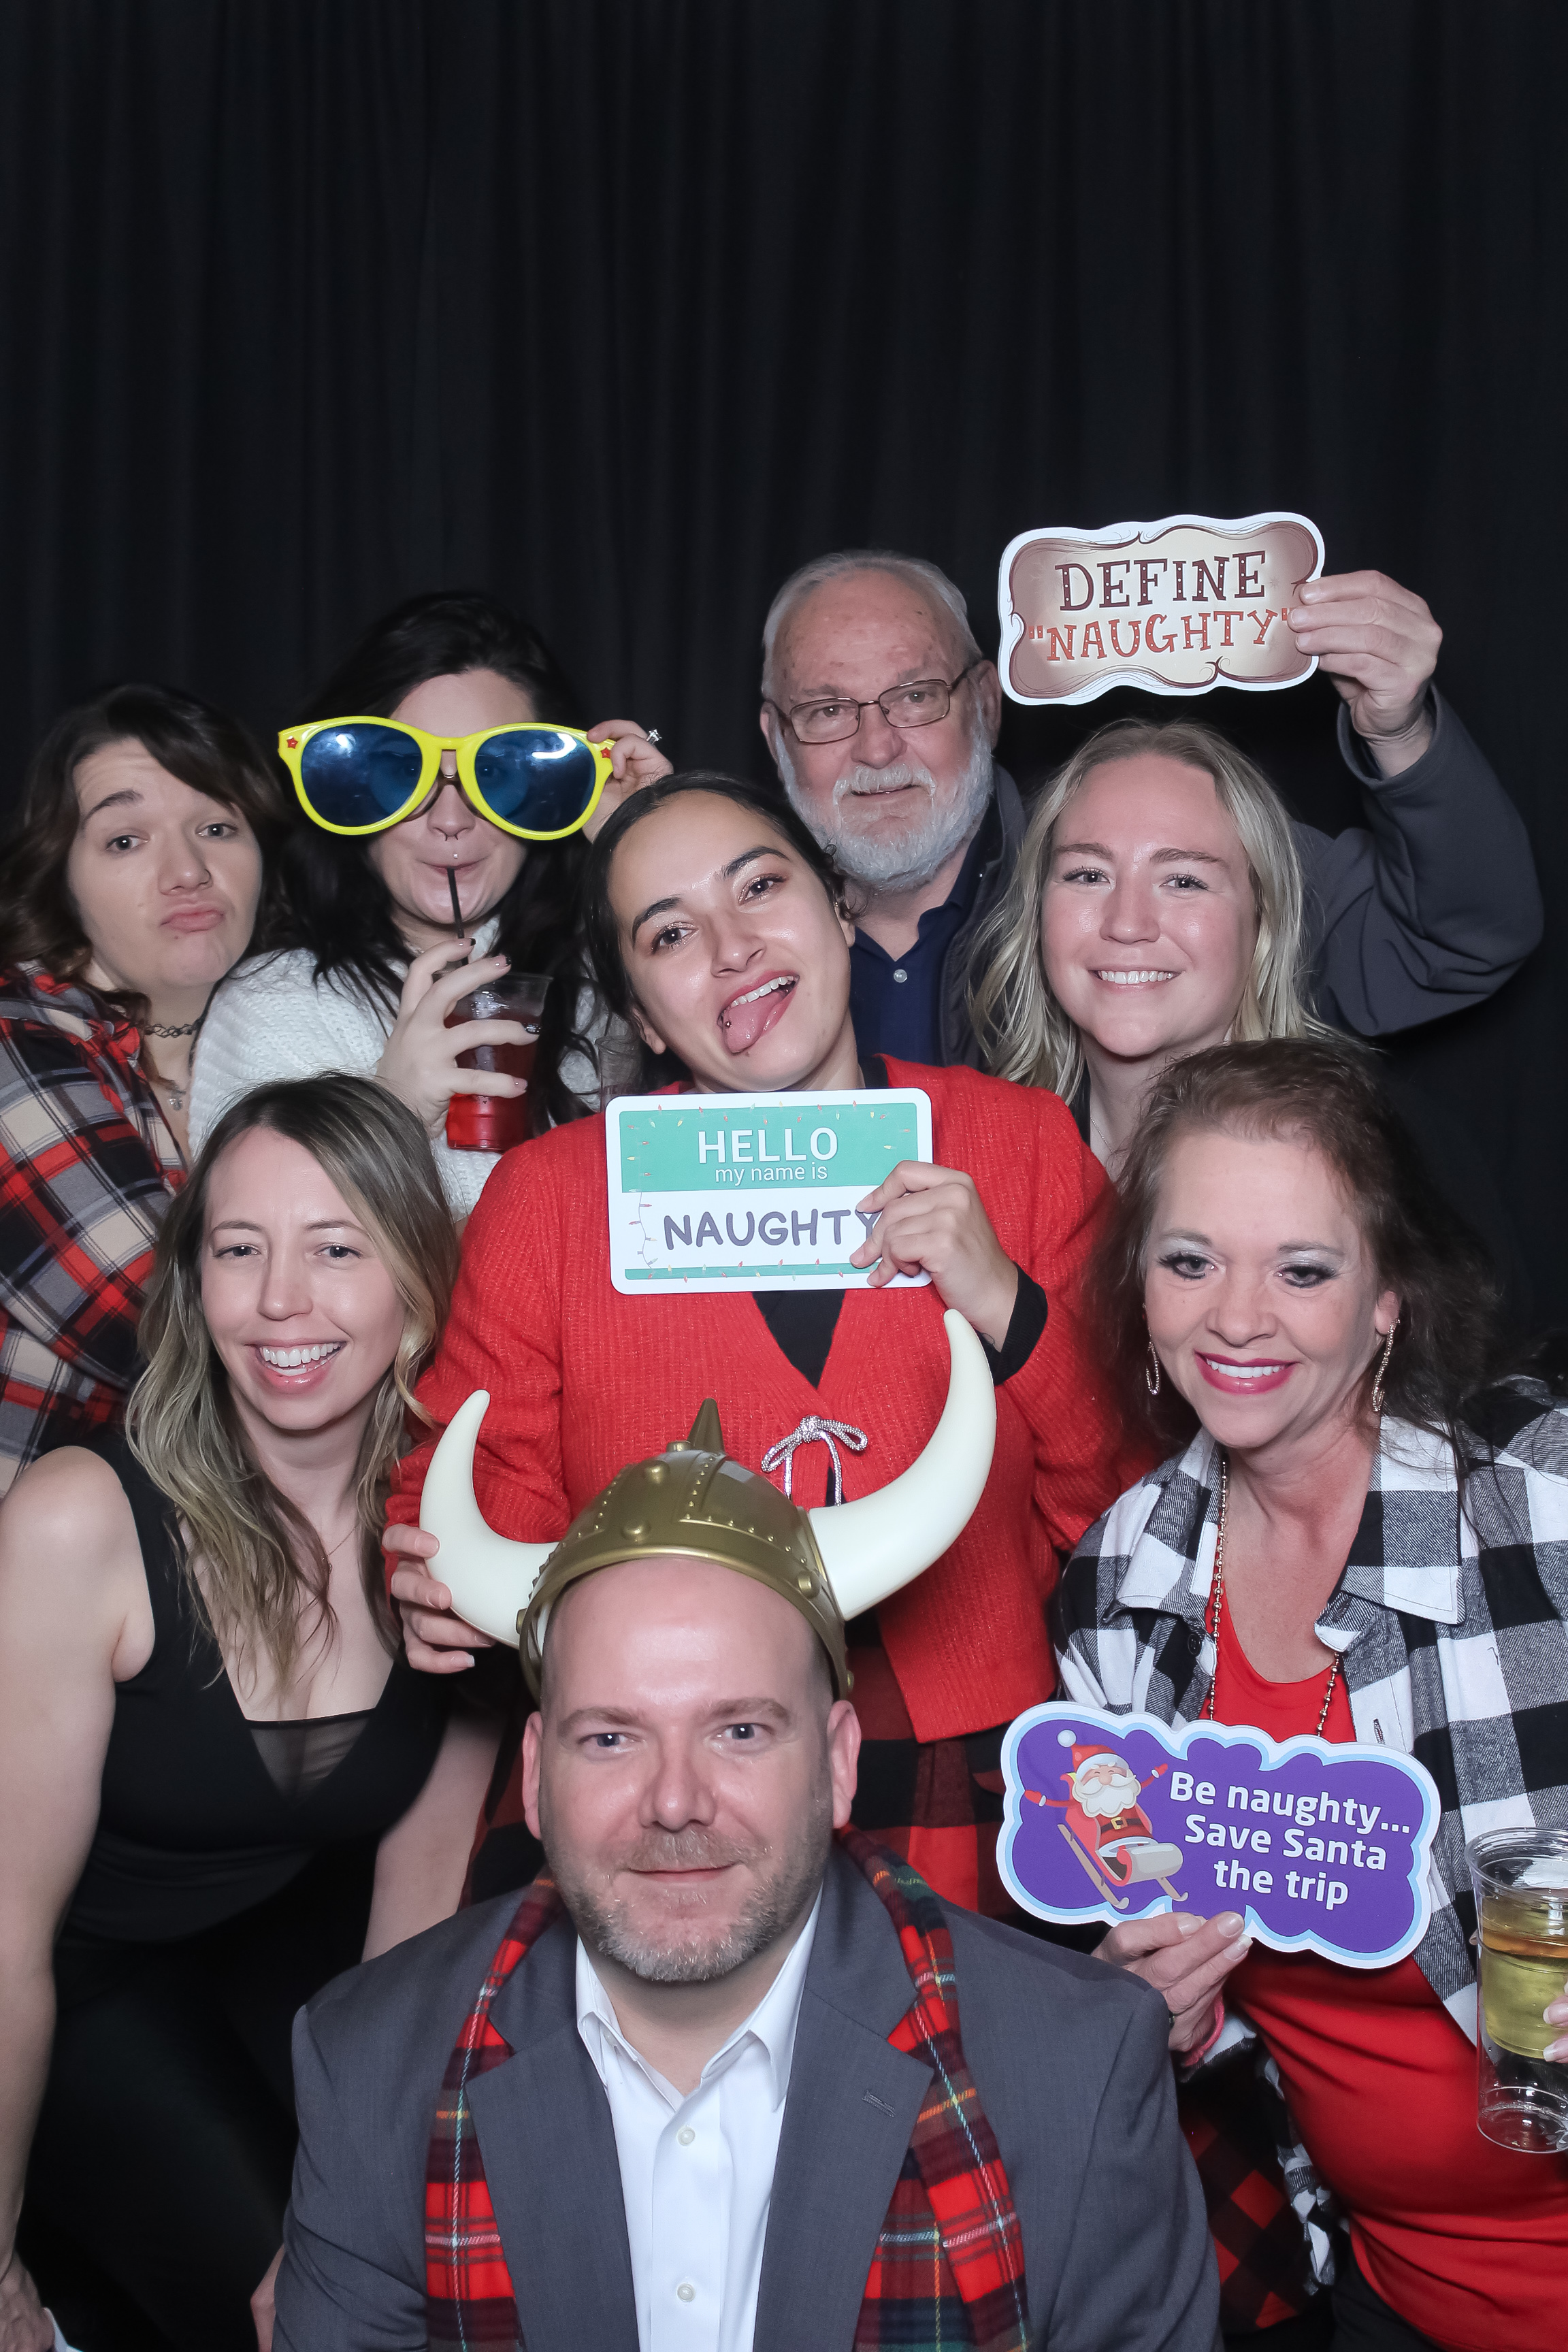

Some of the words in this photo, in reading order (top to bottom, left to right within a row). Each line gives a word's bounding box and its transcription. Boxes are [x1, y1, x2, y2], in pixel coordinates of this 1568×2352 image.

[1054, 550, 1266, 610] DEFINE
[698, 1127, 838, 1164] HELLO
[715, 1168, 745, 1186] my
[751, 1165, 805, 1182] name
[812, 1162, 828, 1179] is
[664, 1208, 882, 1250] NAUGHTY
[1170, 1771, 1215, 1806] Be
[1227, 1784, 1411, 1834] naughty...
[1184, 1814, 1271, 1853] Save
[1283, 1829, 1387, 1870] Santa
[1214, 1859, 1273, 1893] the
[1286, 1870, 1349, 1910] trip
